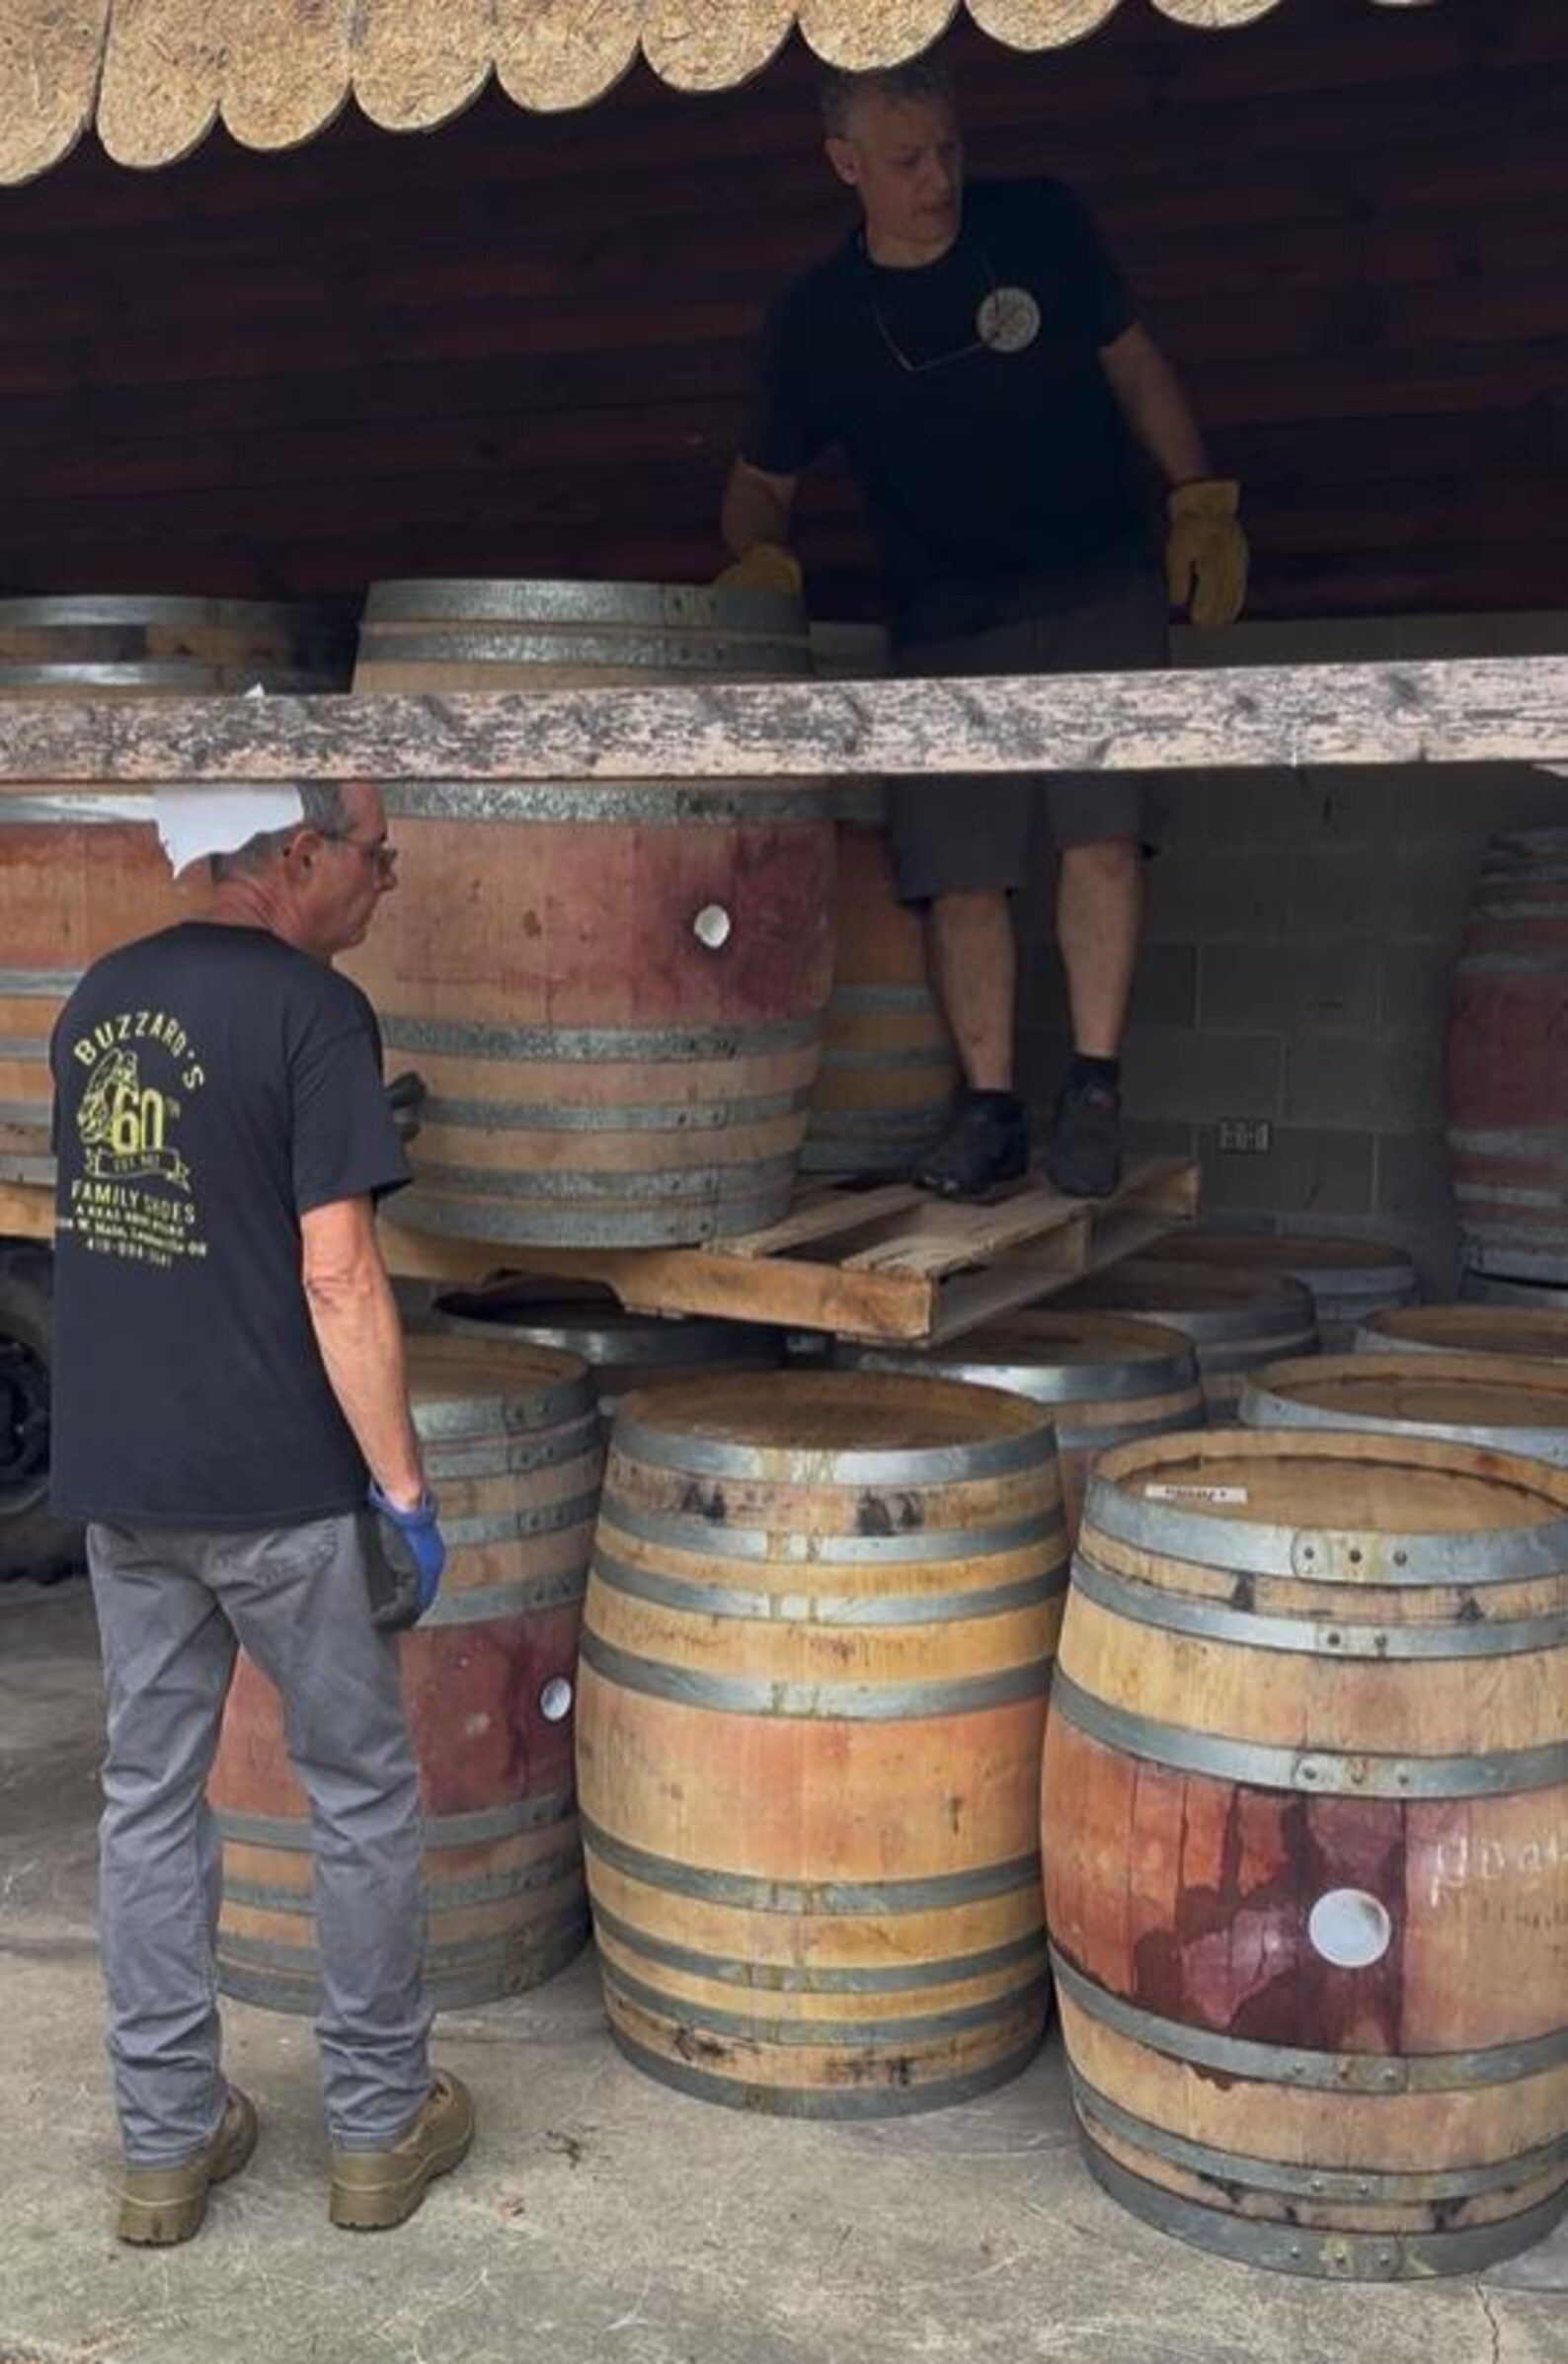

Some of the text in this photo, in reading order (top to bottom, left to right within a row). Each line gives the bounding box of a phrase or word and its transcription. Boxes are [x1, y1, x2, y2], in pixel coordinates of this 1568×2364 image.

[74, 1009, 204, 1090] BUZZARD'S
[71, 1179, 196, 1224] FAMILY SHOES
